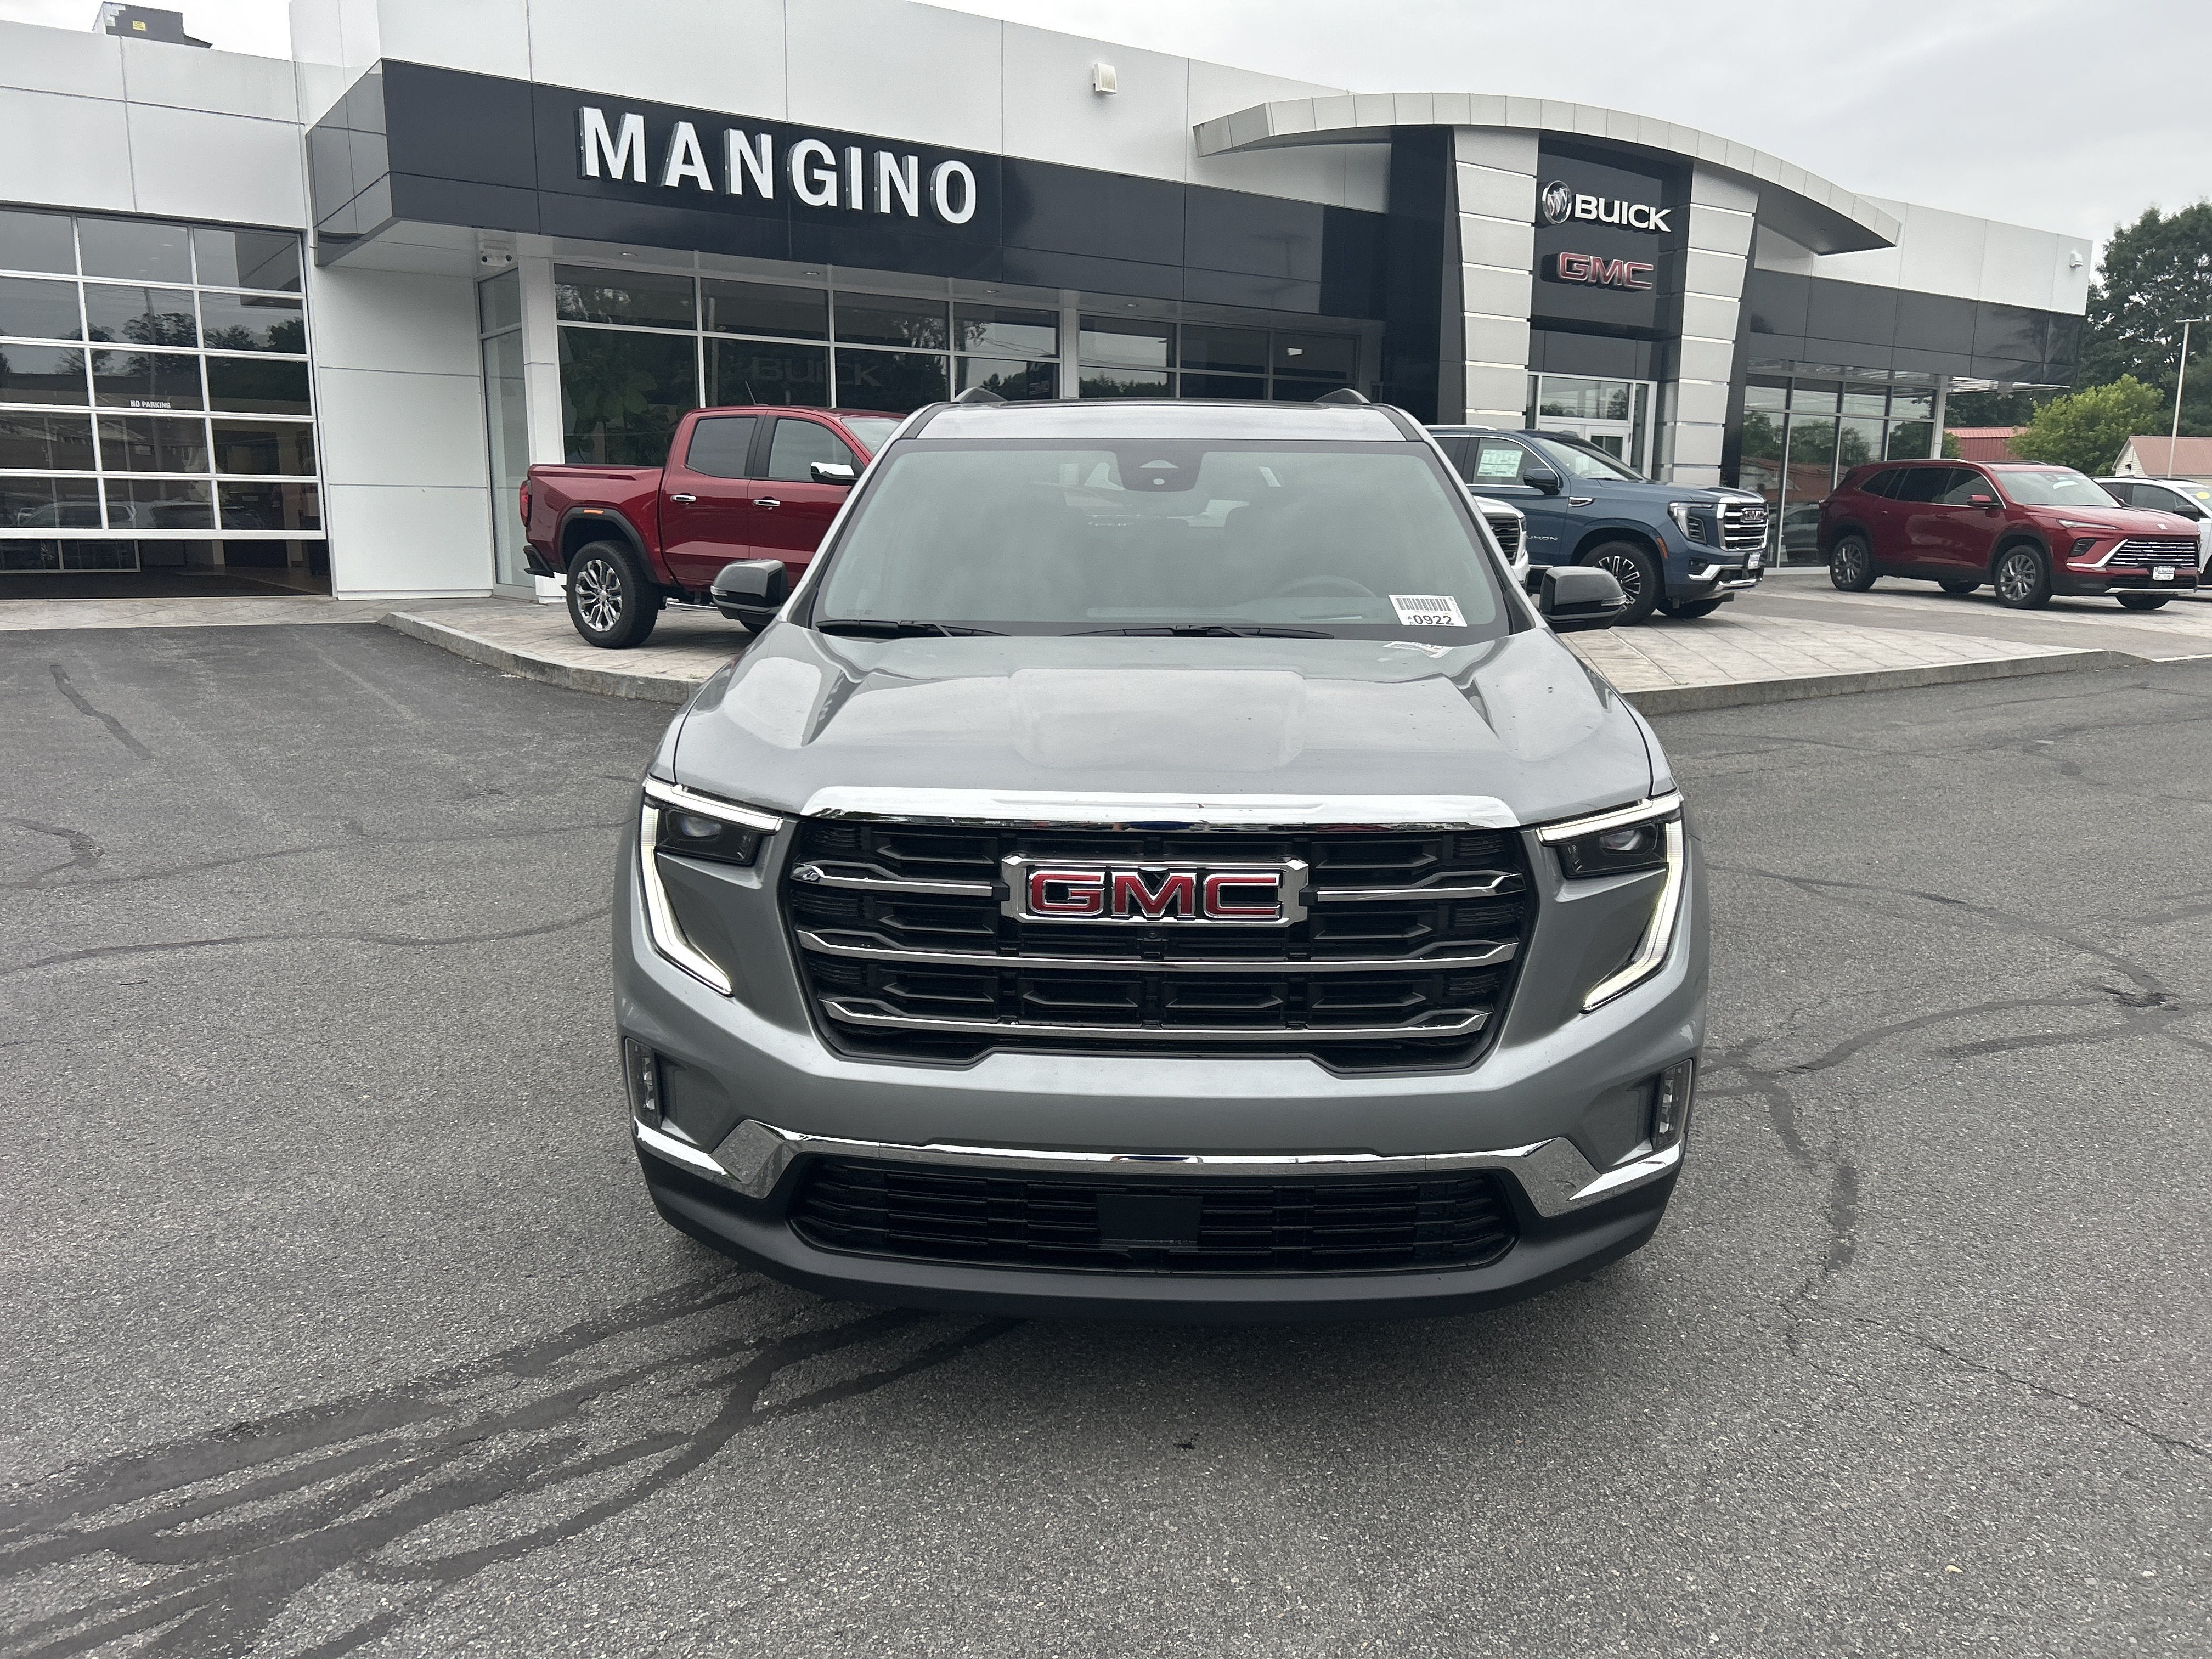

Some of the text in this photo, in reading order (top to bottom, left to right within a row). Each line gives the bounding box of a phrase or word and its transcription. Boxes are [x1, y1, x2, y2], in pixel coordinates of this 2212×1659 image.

[579, 106, 977, 224] MANGINO
[1575, 194, 1671, 232] BUICK
[1559, 252, 1654, 290] GMC
[1413, 614, 1454, 625] 0922
[1028, 868, 1283, 920] GMC
